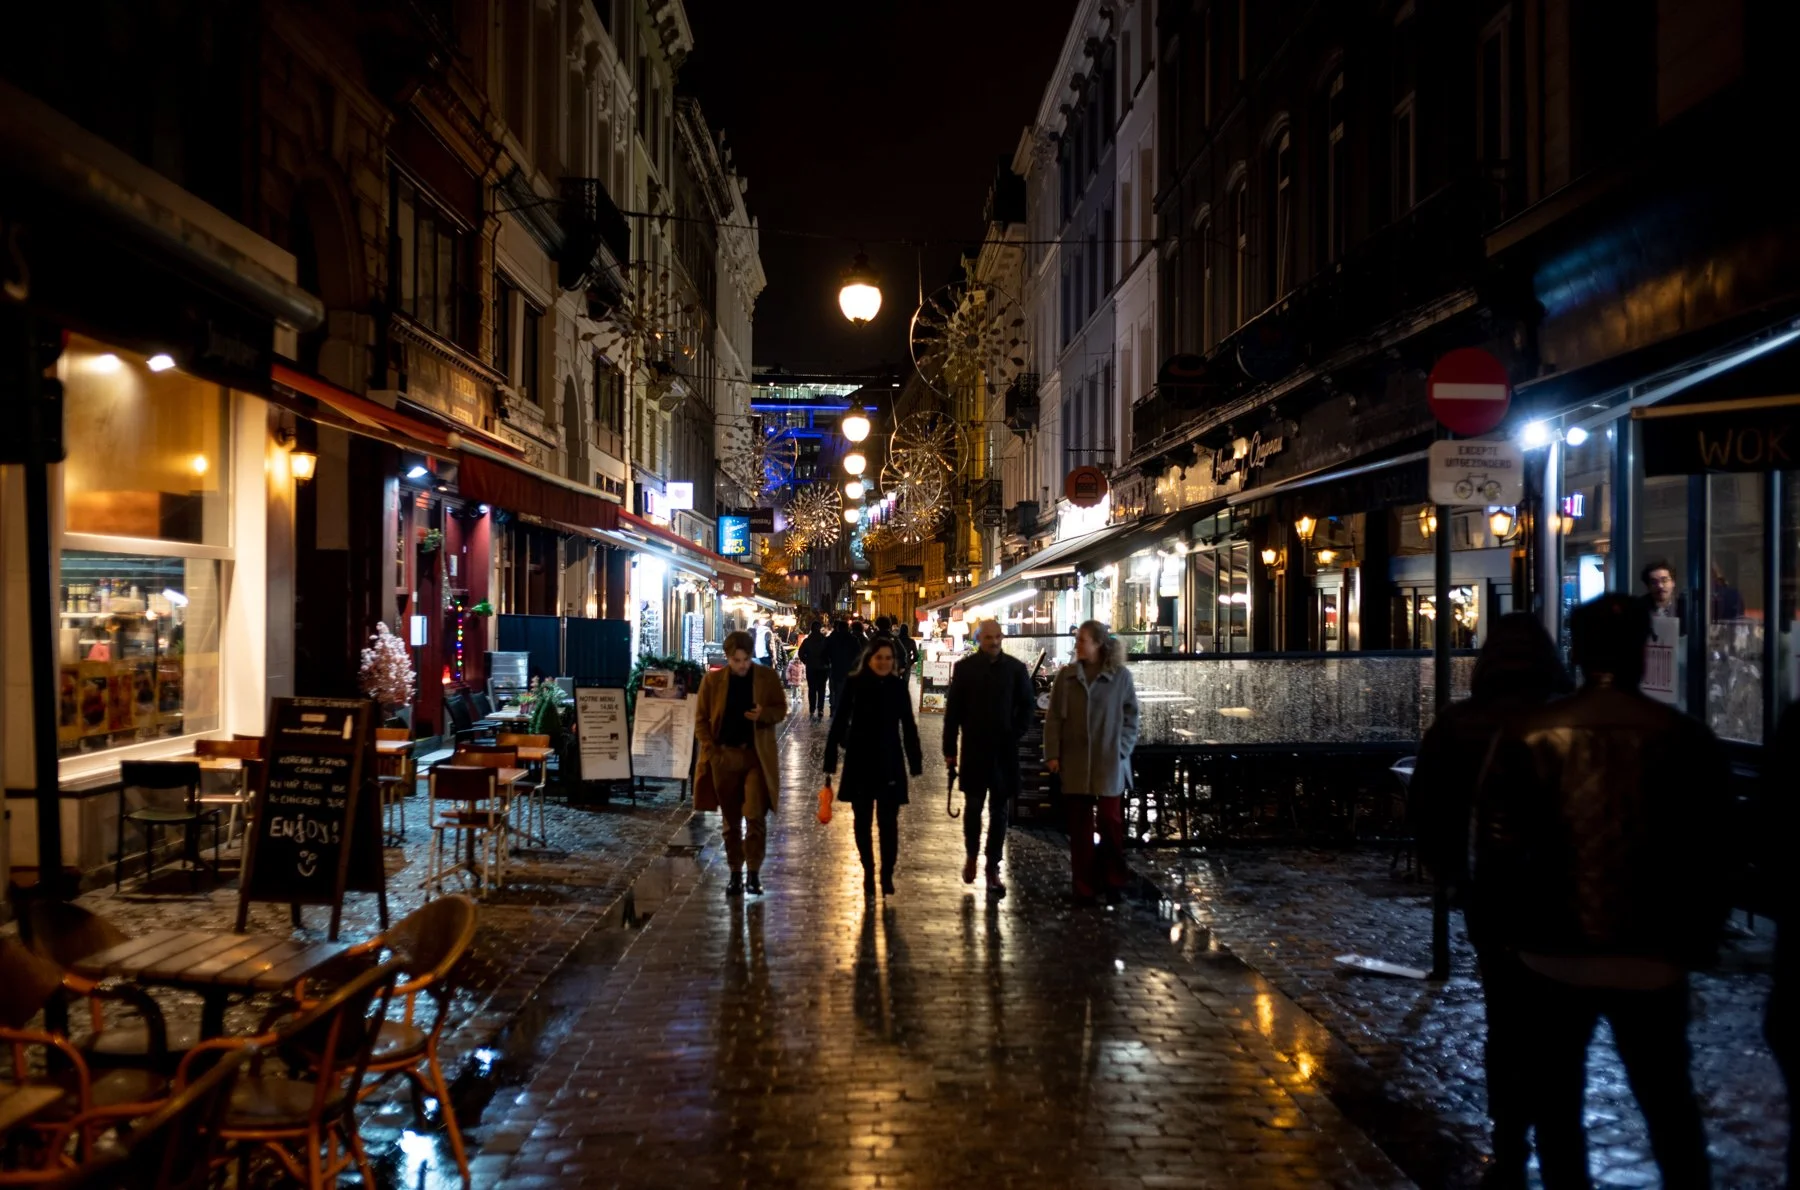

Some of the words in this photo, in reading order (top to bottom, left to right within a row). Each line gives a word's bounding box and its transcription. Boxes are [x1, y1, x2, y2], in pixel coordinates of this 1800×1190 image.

[1697, 424, 1793, 466] WOK
[1444, 457, 1513, 468] UITGEZONDERD
[722, 546, 746, 554] SHOP
